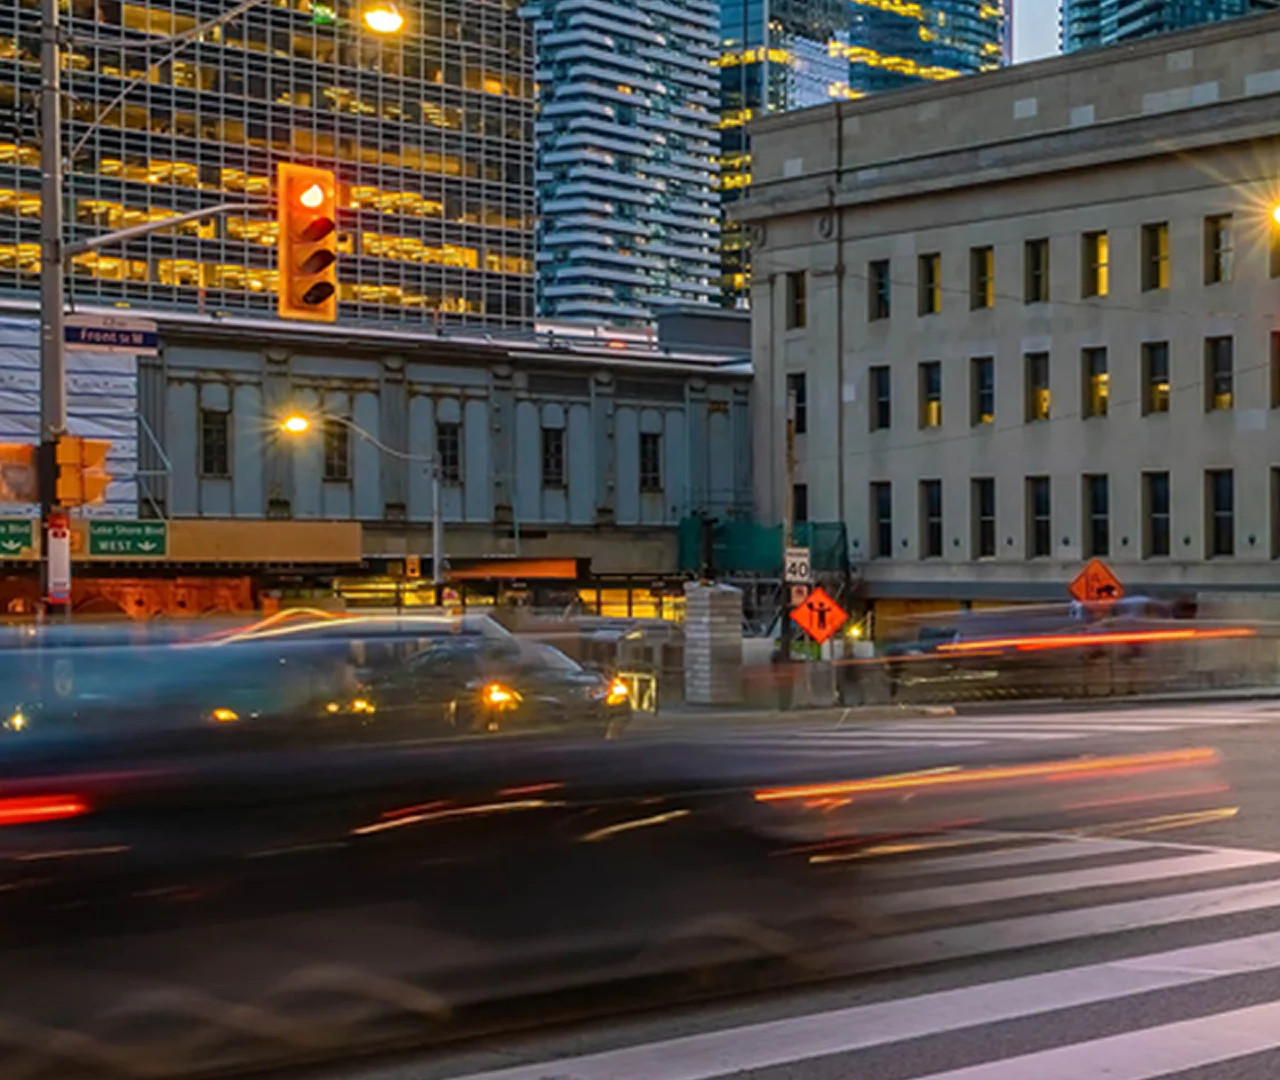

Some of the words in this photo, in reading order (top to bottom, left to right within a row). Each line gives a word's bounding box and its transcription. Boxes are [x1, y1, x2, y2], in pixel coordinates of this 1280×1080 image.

[116, 523, 142, 535] Shore
[98, 540, 132, 551] WEST
[788, 562, 809, 577] 40
